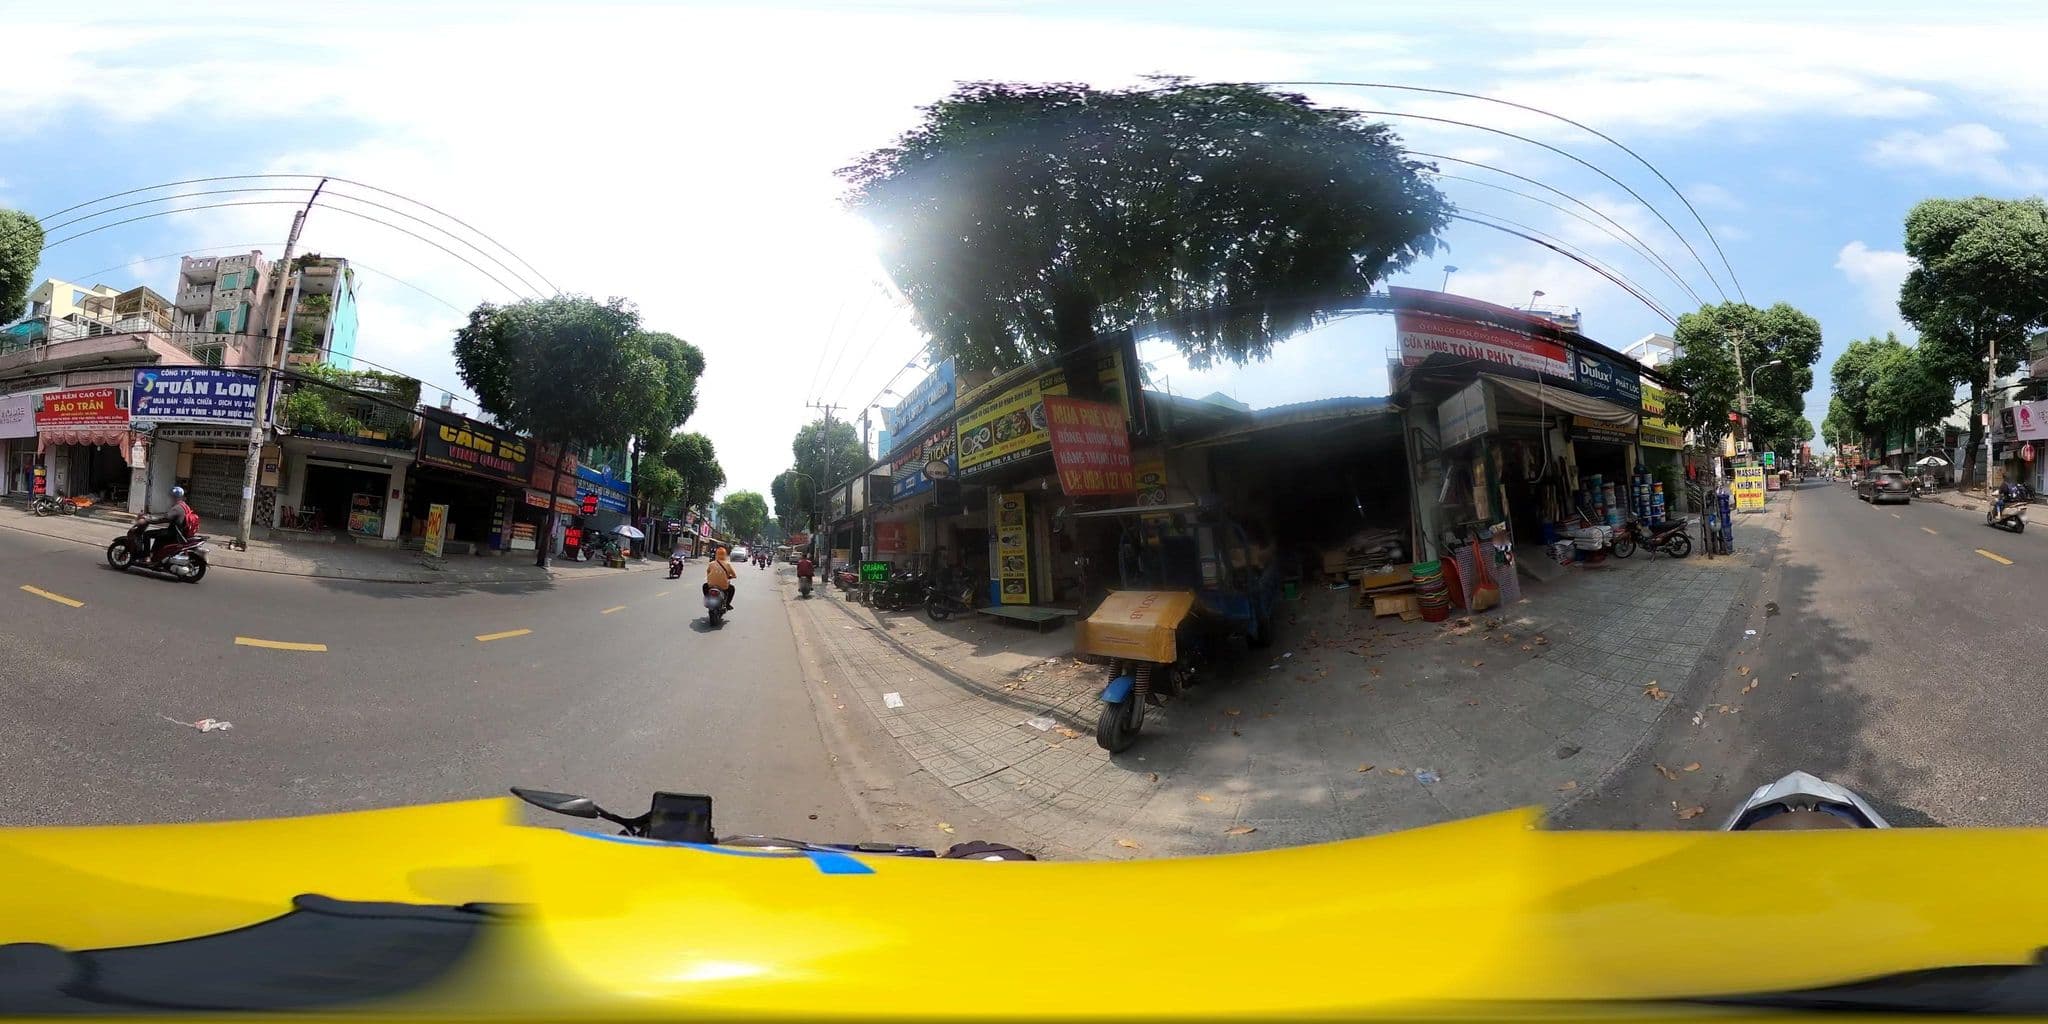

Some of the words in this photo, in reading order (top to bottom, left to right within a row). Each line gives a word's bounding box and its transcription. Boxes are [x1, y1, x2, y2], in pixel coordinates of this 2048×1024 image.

[1423, 339, 1448, 352] HÀNG
[1449, 342, 1484, 360] TOÀN
[161, 369, 178, 377] CÔNG
[1580, 361, 1609, 383] Dulux
[96, 388, 113, 397] CẤP
[155, 377, 209, 394] TUẤN
[215, 382, 257, 397] LON
[53, 400, 74, 412] BẢO
[76, 399, 104, 410] TRÂN
[176, 407, 189, 415] MÁY
[191, 407, 207, 415] TÍNH
[1736, 468, 1761, 477] MASSAGE
